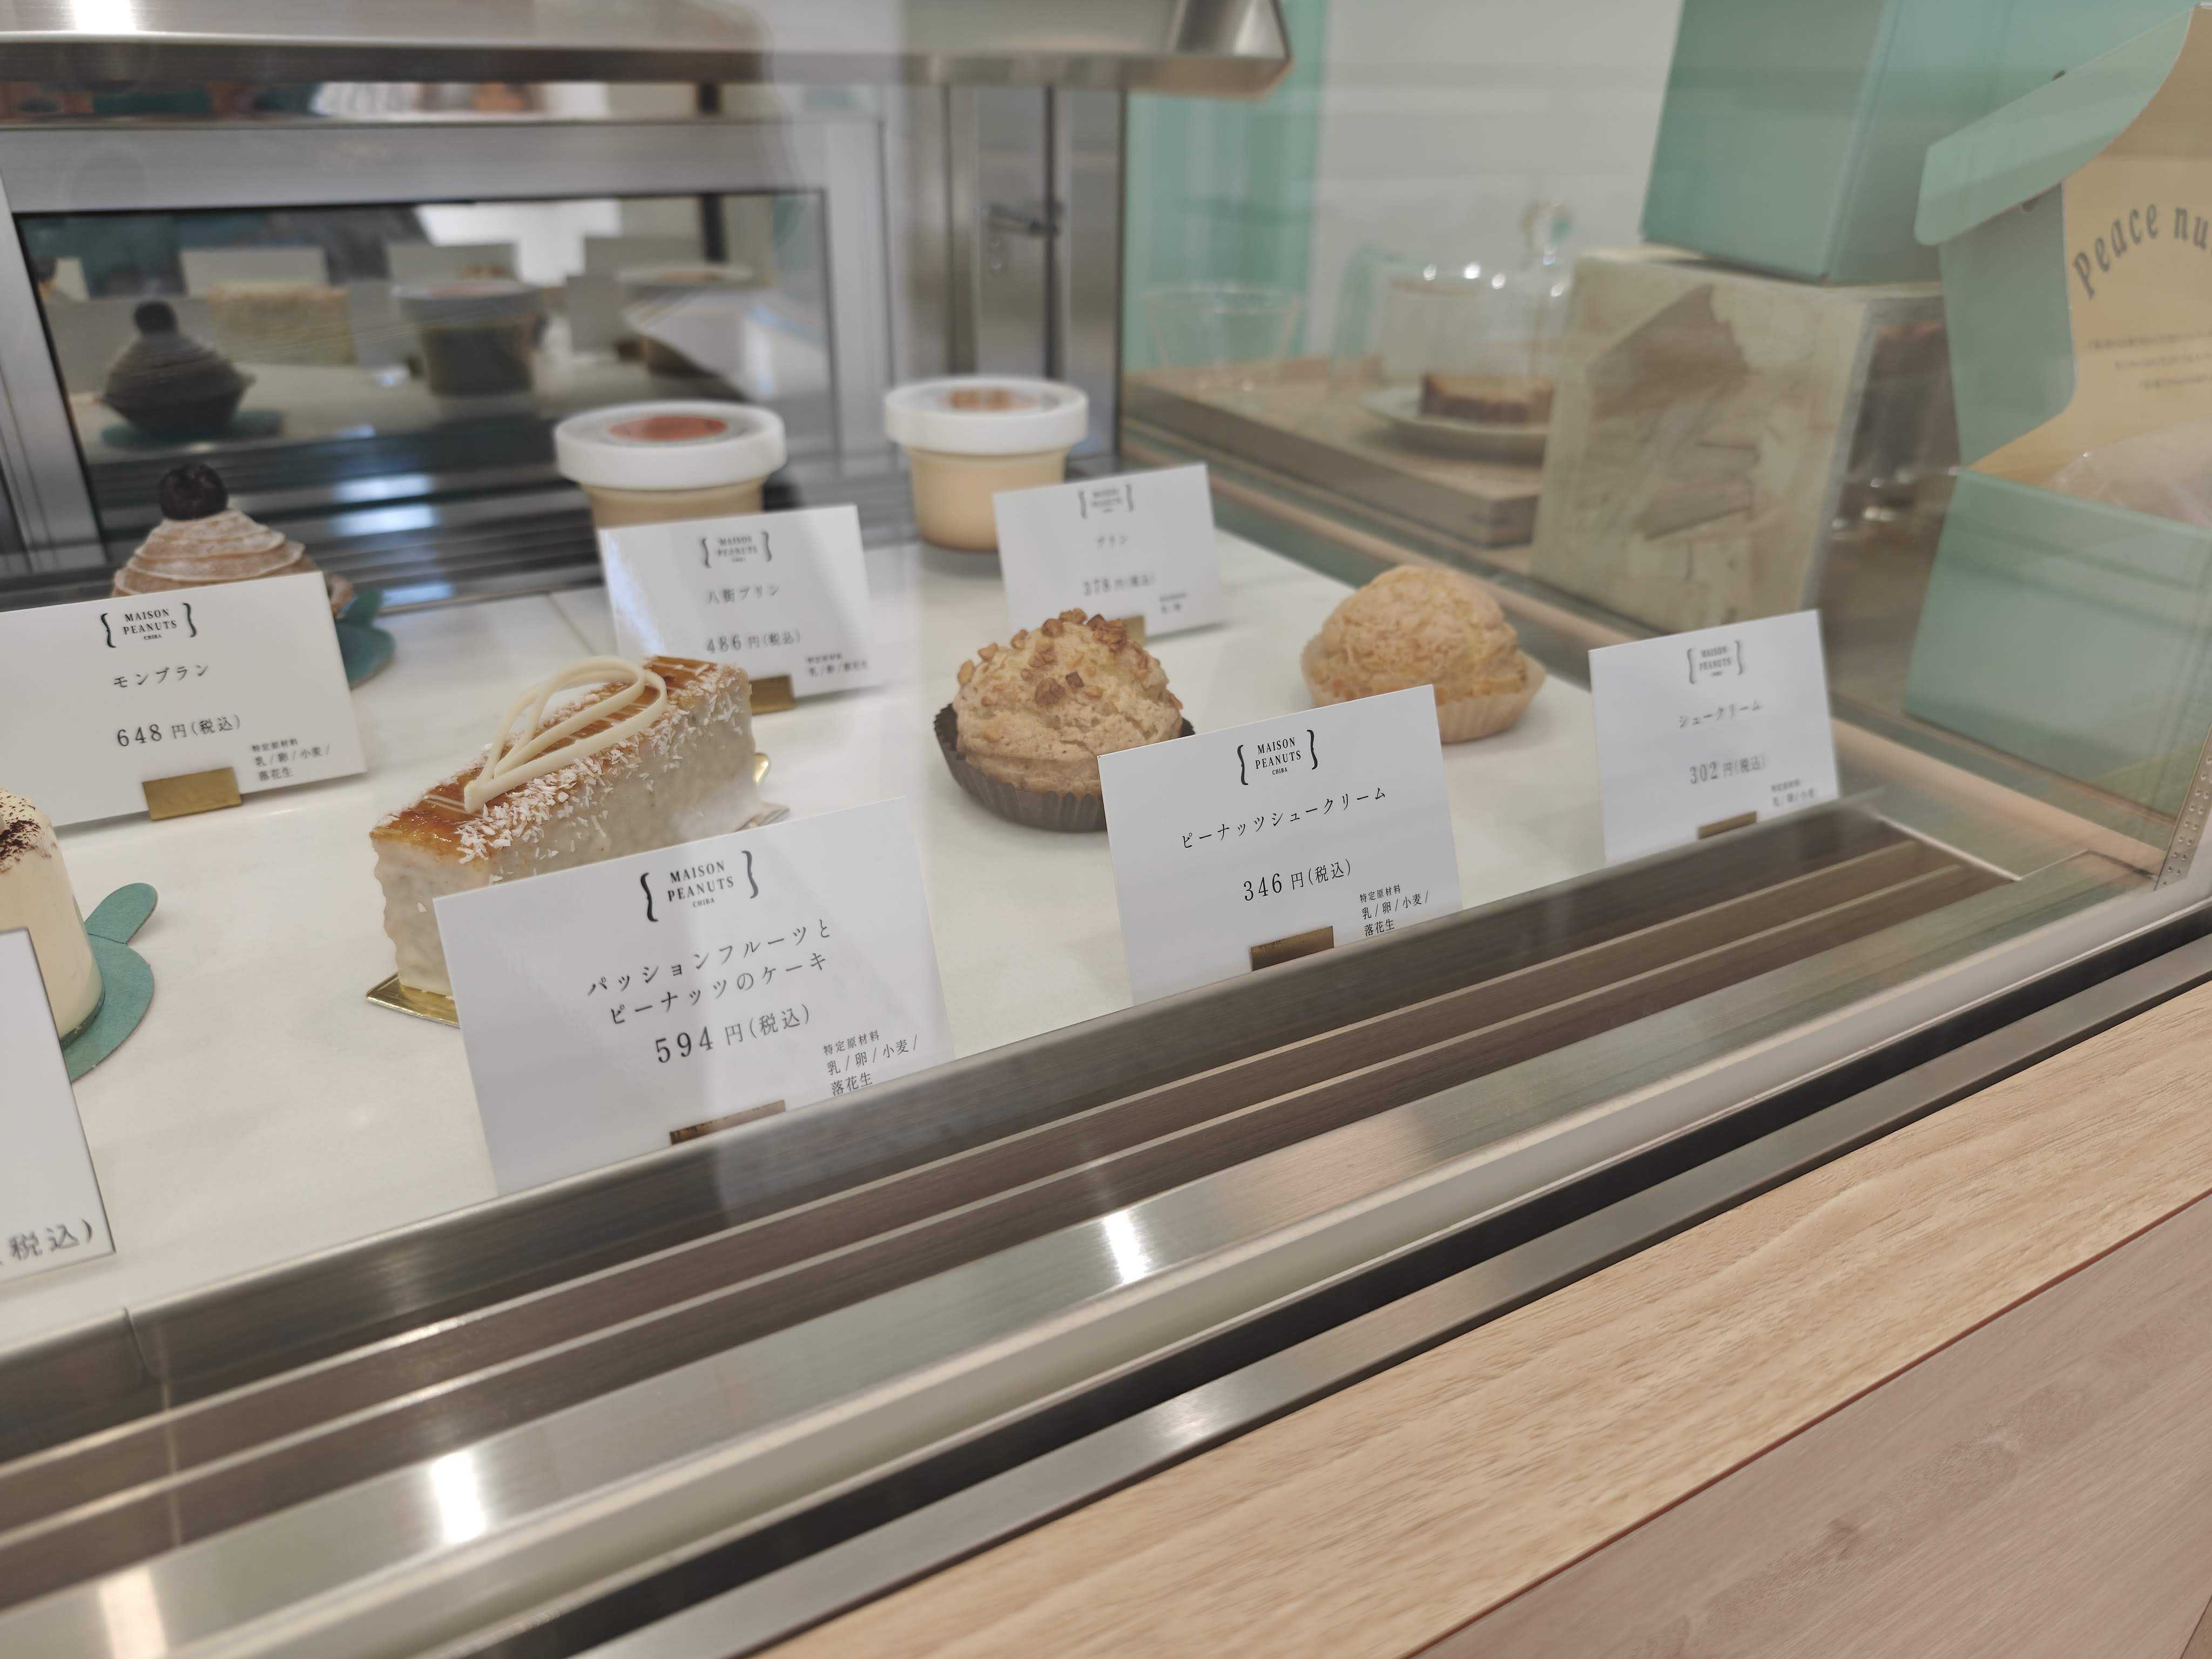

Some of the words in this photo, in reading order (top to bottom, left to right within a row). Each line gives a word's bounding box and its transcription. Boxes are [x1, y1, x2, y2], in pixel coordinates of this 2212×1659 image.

[2173, 206, 2211, 251] nu
[125, 608, 170, 622] MAISON
[123, 620, 177, 635] PEANUTS
[114, 665, 208, 687] モンブラン
[116, 724, 162, 746] 648
[1257, 737, 1295, 754] MAISON
[1255, 750, 1301, 769] PEANUTS
[1182, 787, 1386, 848] ピーナッツシュークリーム
[670, 860, 725, 884] MAISON
[667, 876, 734, 901] PEANUTS
[1243, 873, 1283, 901] 346
[1360, 884, 1400, 903] 特定原材料
[692, 897, 715, 907] CHIBA
[1364, 919, 1395, 937] 落花生
[588, 919, 831, 997] パッションフルーツと
[611, 953, 826, 1025] ピーナッツのケーキ
[655, 1026, 714, 1063] 594
[823, 1029, 880, 1056] 特定原材料
[831, 1072, 873, 1096] 落花生
